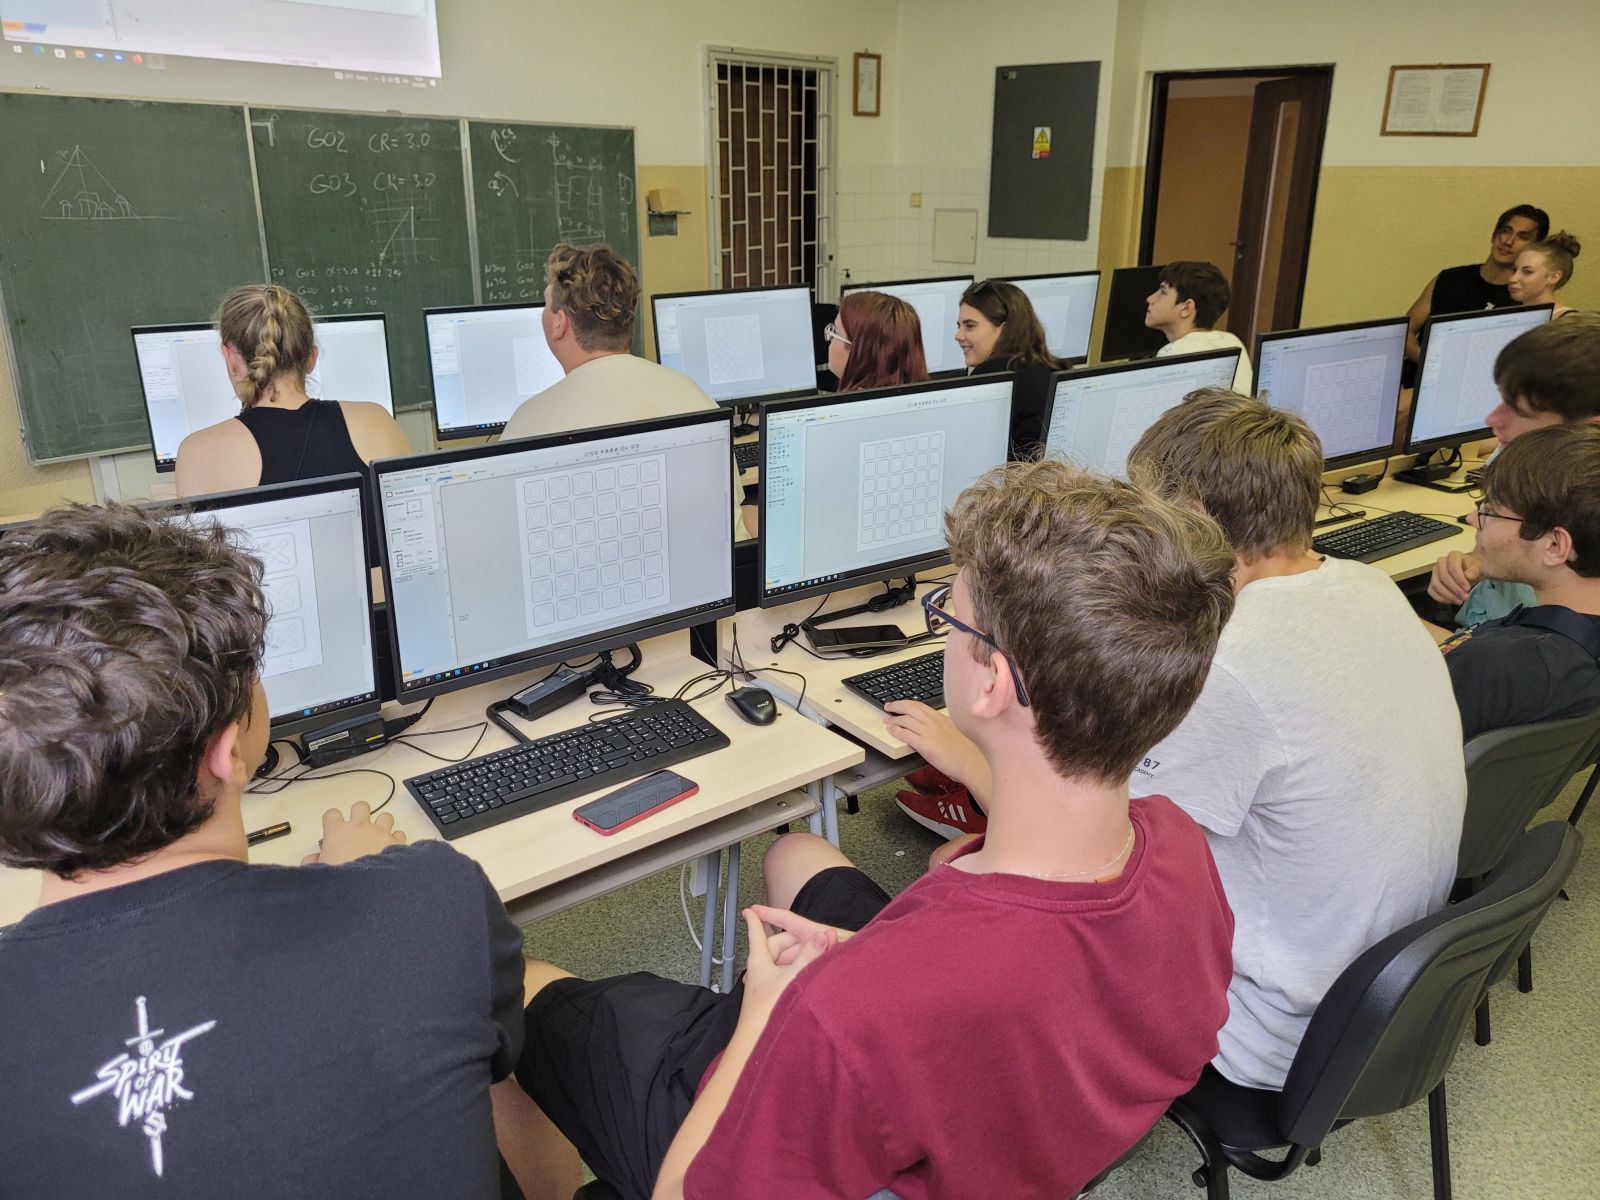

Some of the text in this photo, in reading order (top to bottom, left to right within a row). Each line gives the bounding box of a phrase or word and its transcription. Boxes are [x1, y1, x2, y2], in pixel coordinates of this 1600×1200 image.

[307, 127, 348, 153] G02
[309, 173, 358, 197] G03
[134, 1070, 153, 1090] OF
